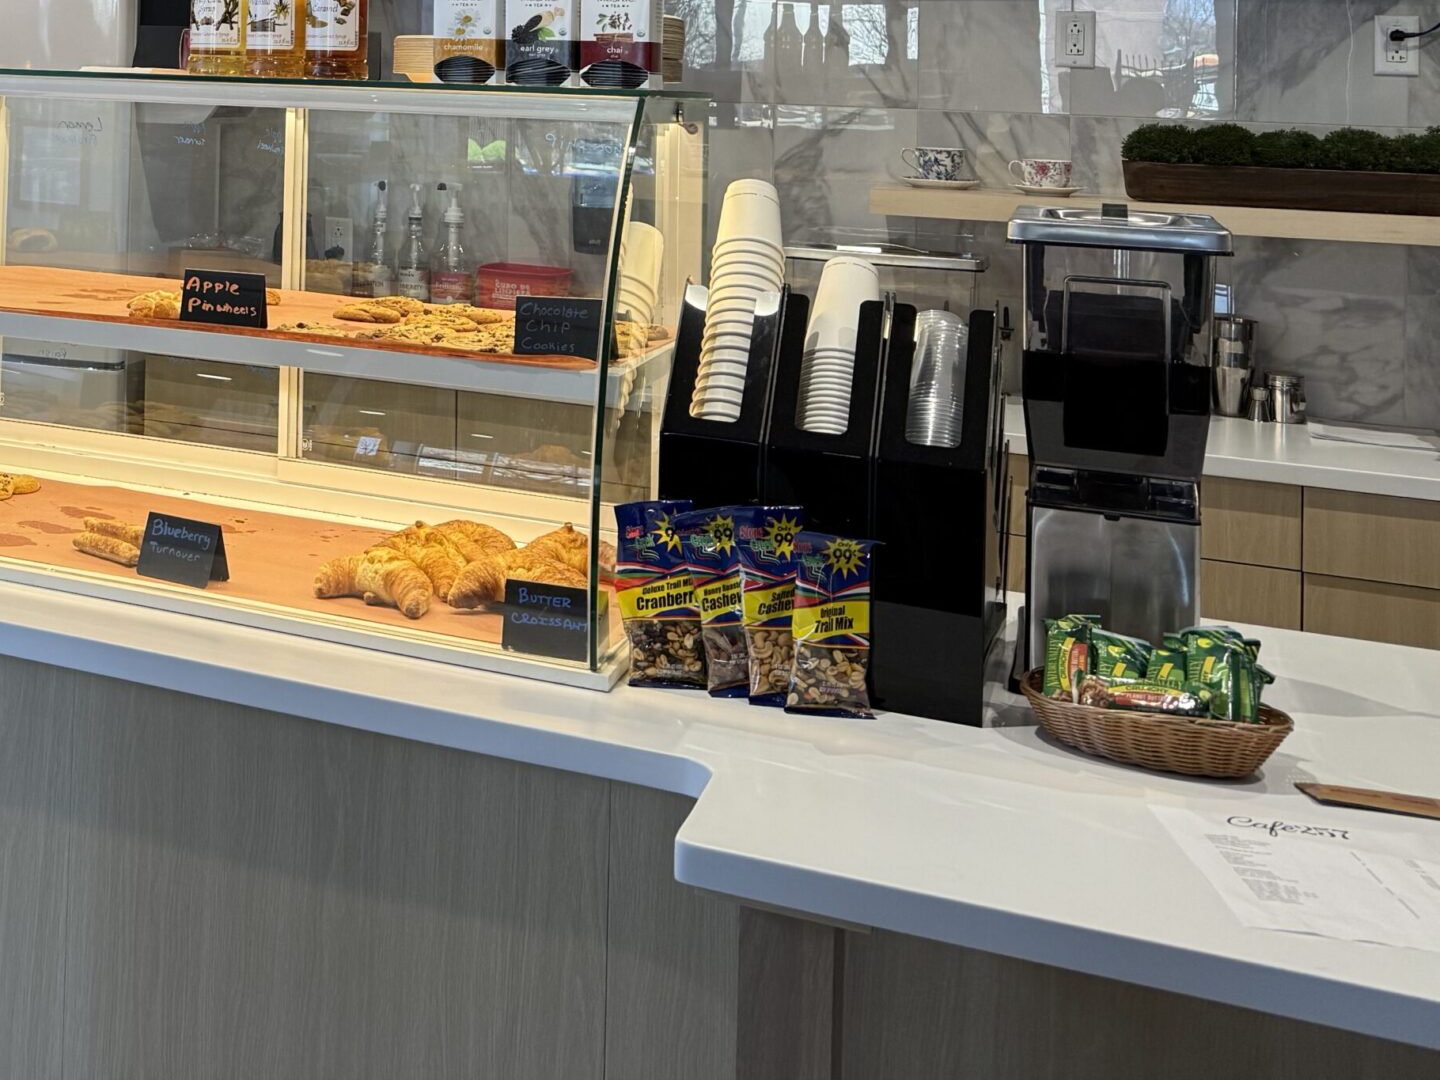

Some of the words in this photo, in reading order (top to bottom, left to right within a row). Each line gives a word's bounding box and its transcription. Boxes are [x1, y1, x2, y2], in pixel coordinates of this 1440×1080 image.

[444, 42, 483, 51] chamomile
[520, 44, 535, 52] earl
[537, 46, 555, 54] grey
[607, 46, 623, 54] chai
[186, 276, 240, 295] Apple
[188, 297, 257, 316] Pinwheels
[520, 302, 589, 318] Chocolate
[526, 320, 570, 334] Chip
[521, 337, 575, 353] Cookies
[152, 518, 210, 550] Blueberry
[150, 541, 200, 561] Turnover
[642, 585, 665, 595] Deluxe
[666, 580, 682, 591] Trail
[519, 587, 571, 608] BUTTER
[636, 590, 694, 610] Cranberr
[757, 599, 793, 615] Cashe
[511, 612, 588, 632] CROISSANT
[835, 616, 854, 630] Mix
